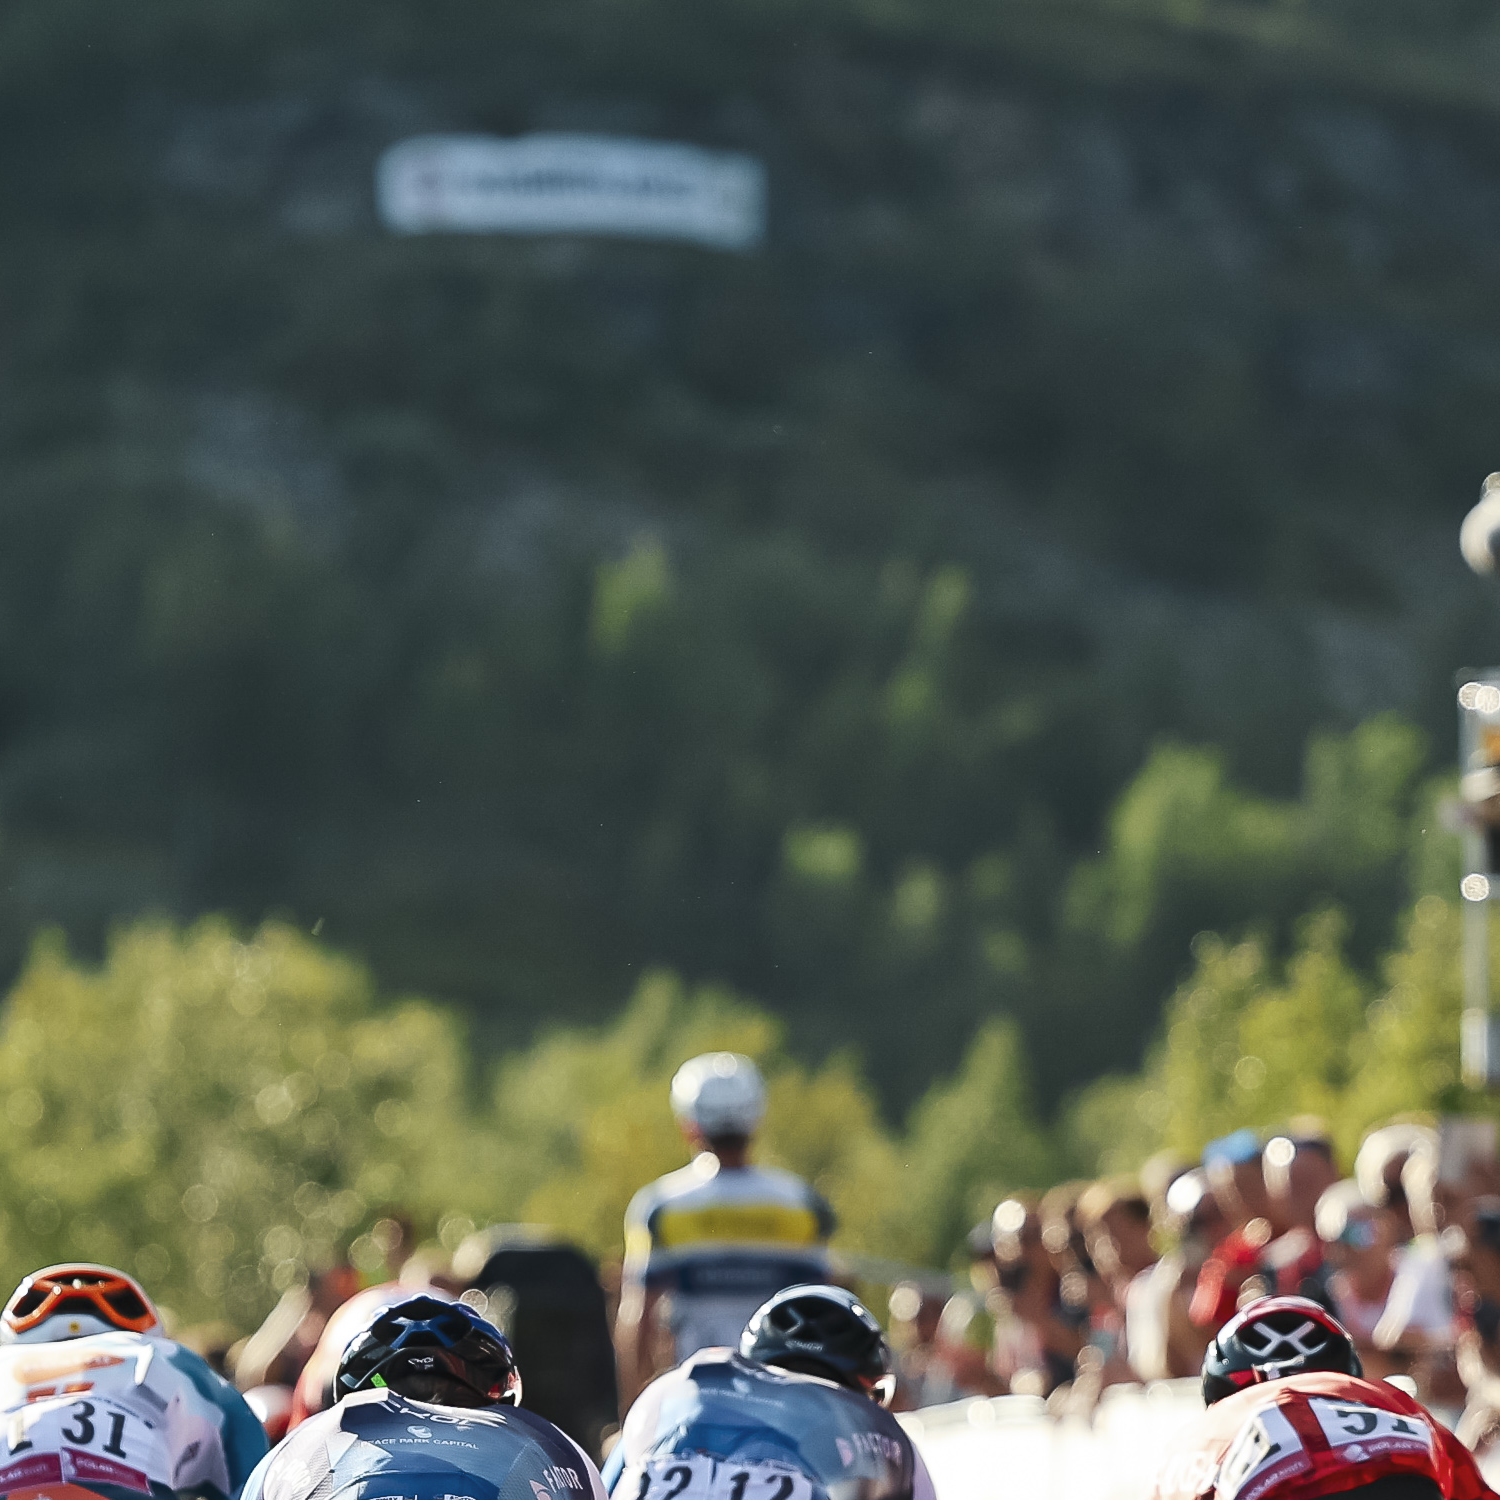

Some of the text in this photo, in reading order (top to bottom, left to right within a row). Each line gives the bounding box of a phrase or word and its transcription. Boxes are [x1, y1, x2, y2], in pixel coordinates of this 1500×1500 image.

[61, 1400, 128, 1459] 31
[399, 1437, 430, 1445] PARK
[432, 1438, 480, 1450] CAPITAL
